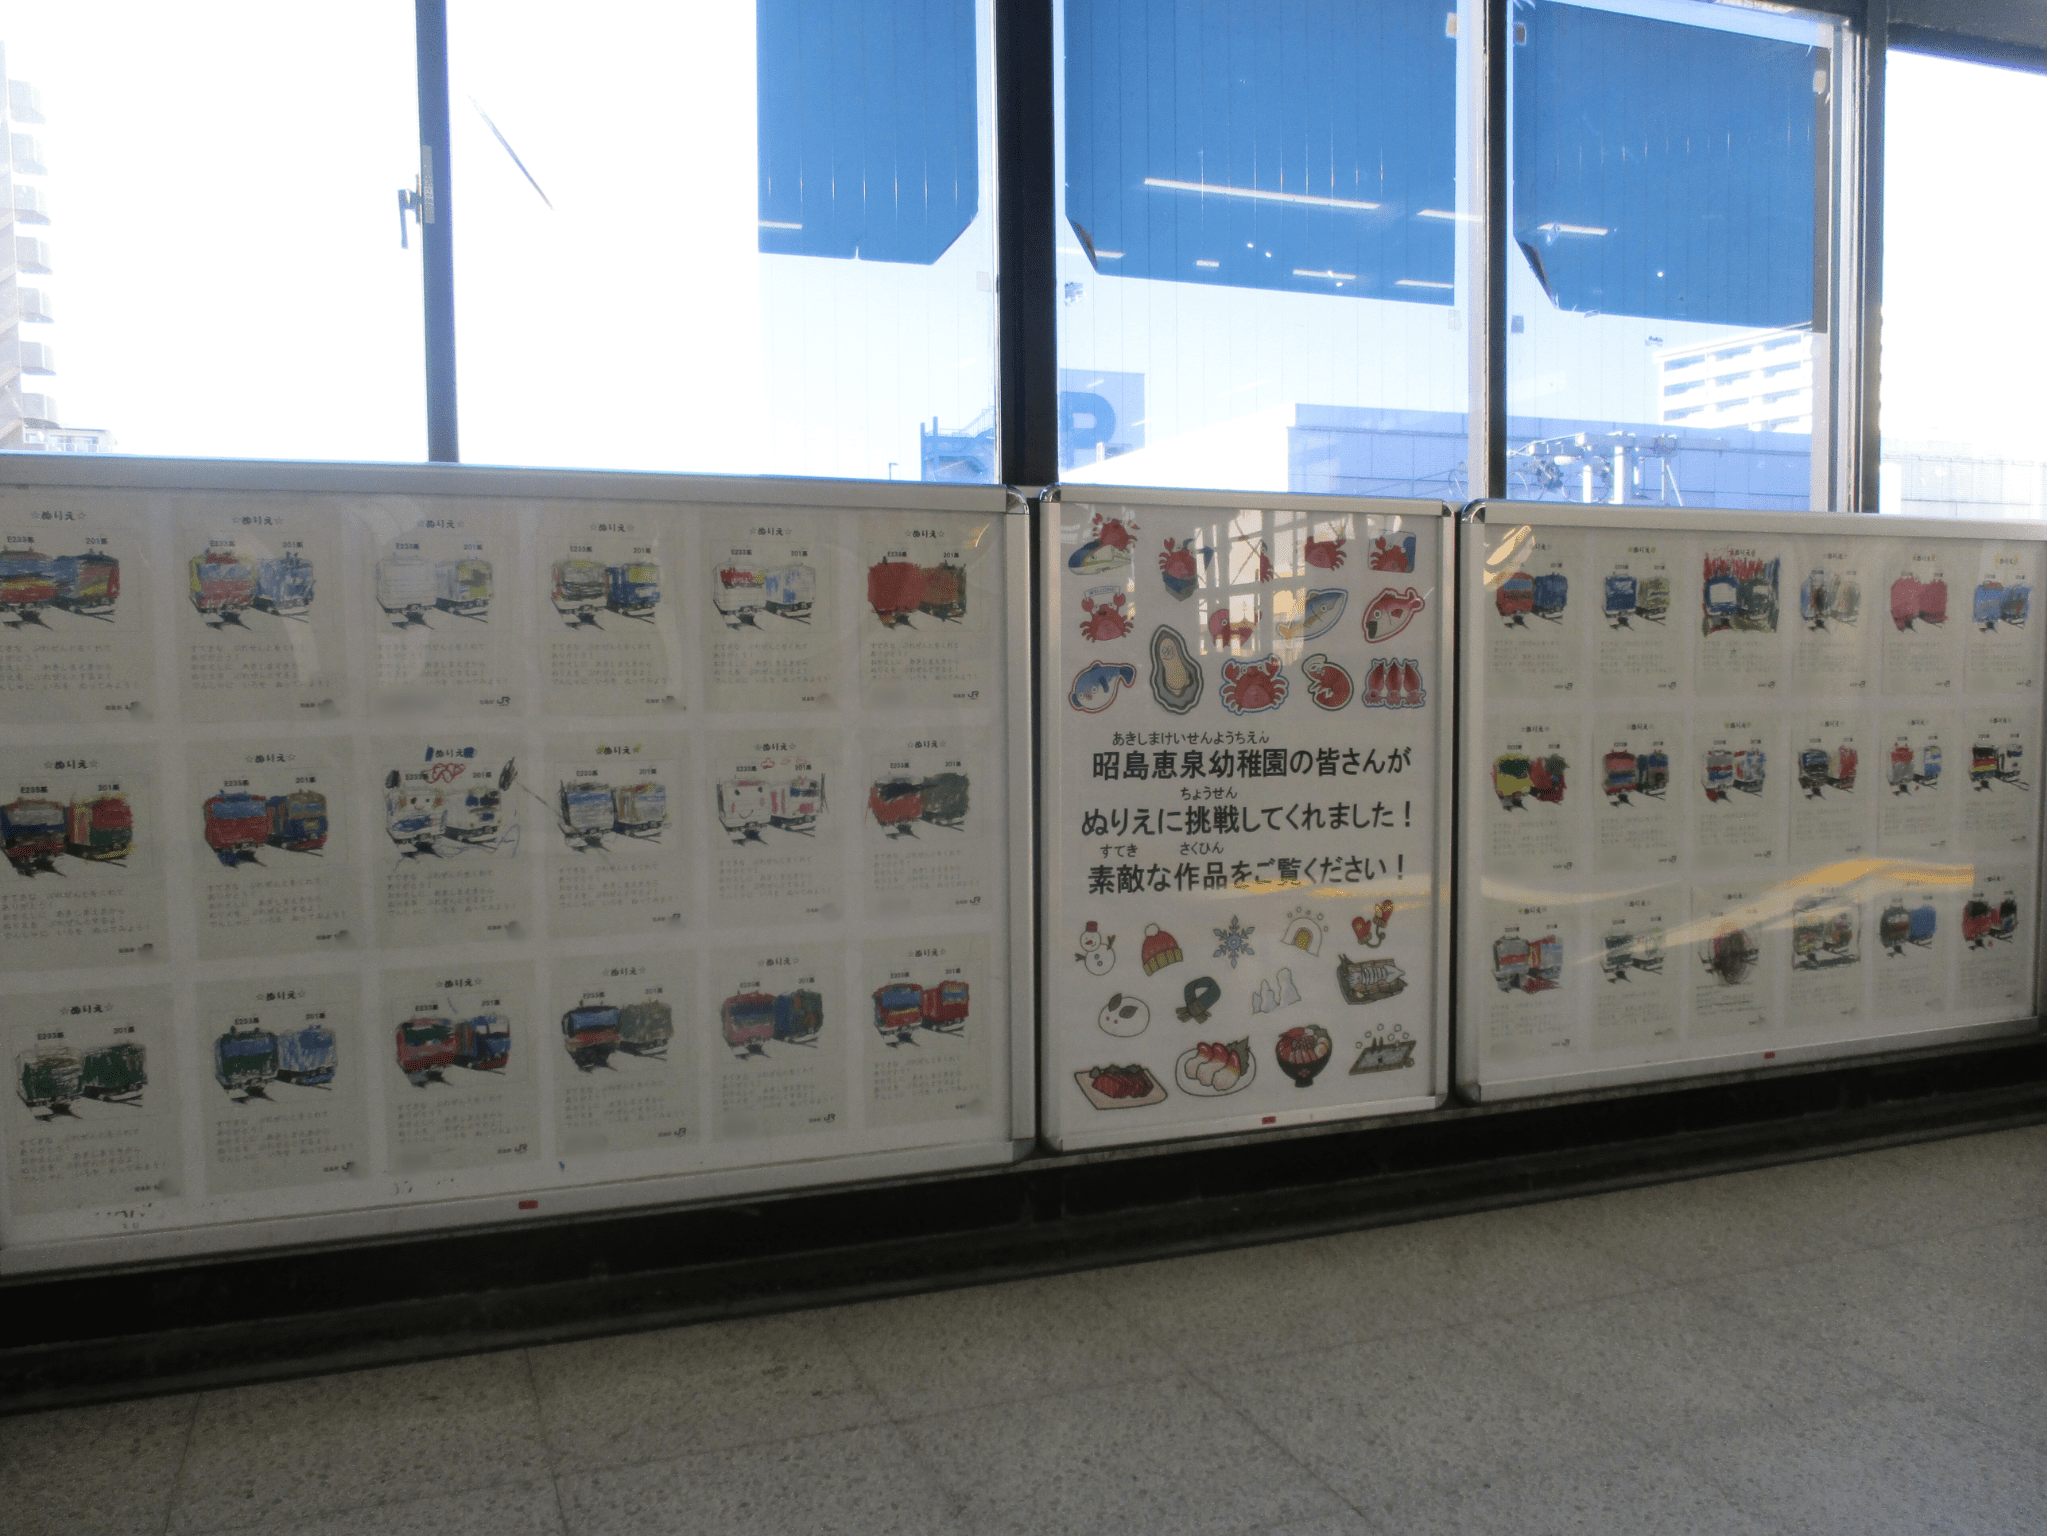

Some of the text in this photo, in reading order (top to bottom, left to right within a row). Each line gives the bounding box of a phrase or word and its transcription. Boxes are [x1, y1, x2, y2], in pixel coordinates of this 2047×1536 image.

[1112, 731, 1269, 745] あきしまけいせんようちえん
[1092, 747, 1412, 781] 昭島恵泉幼稚園の皆さんが
[1180, 786, 1237, 800] ちょうせん
[1081, 801, 1412, 837] ぬりえに挑戦してくれました！
[1100, 841, 1224, 858] すてき さくひん
[1087, 854, 1404, 895] 素敵な作品をご覧ください！
